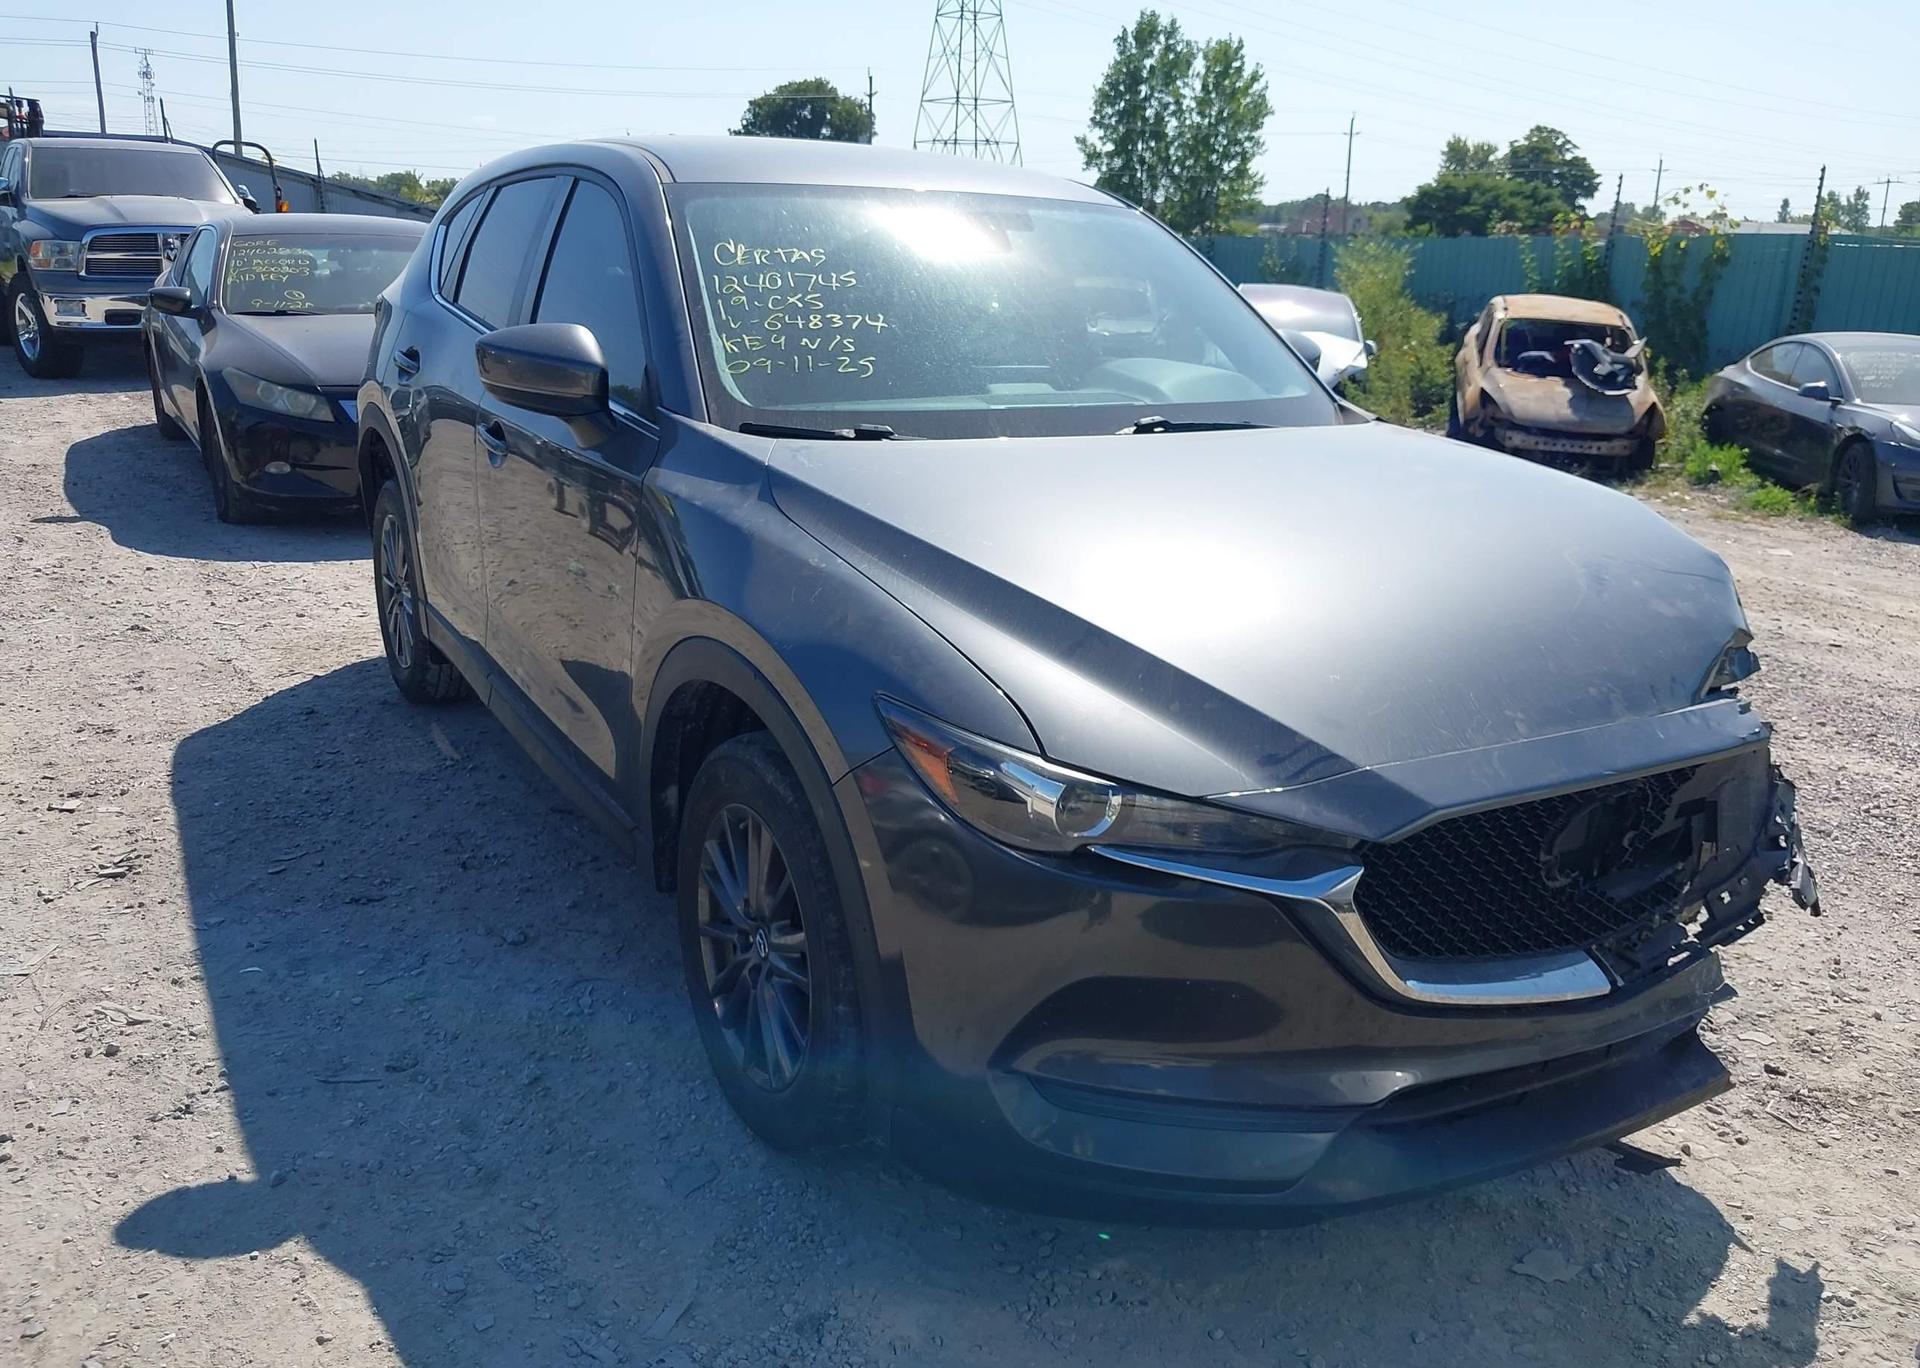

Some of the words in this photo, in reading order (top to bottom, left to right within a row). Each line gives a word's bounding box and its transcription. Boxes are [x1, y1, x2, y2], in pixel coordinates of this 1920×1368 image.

[252, 258, 310, 266] ACCORD
[713, 238, 827, 267] CERTAS
[260, 273, 289, 283] KEY
[712, 271, 858, 294] 12401745
[729, 313, 888, 334] V-648374
[726, 355, 877, 378] 09-11-25
